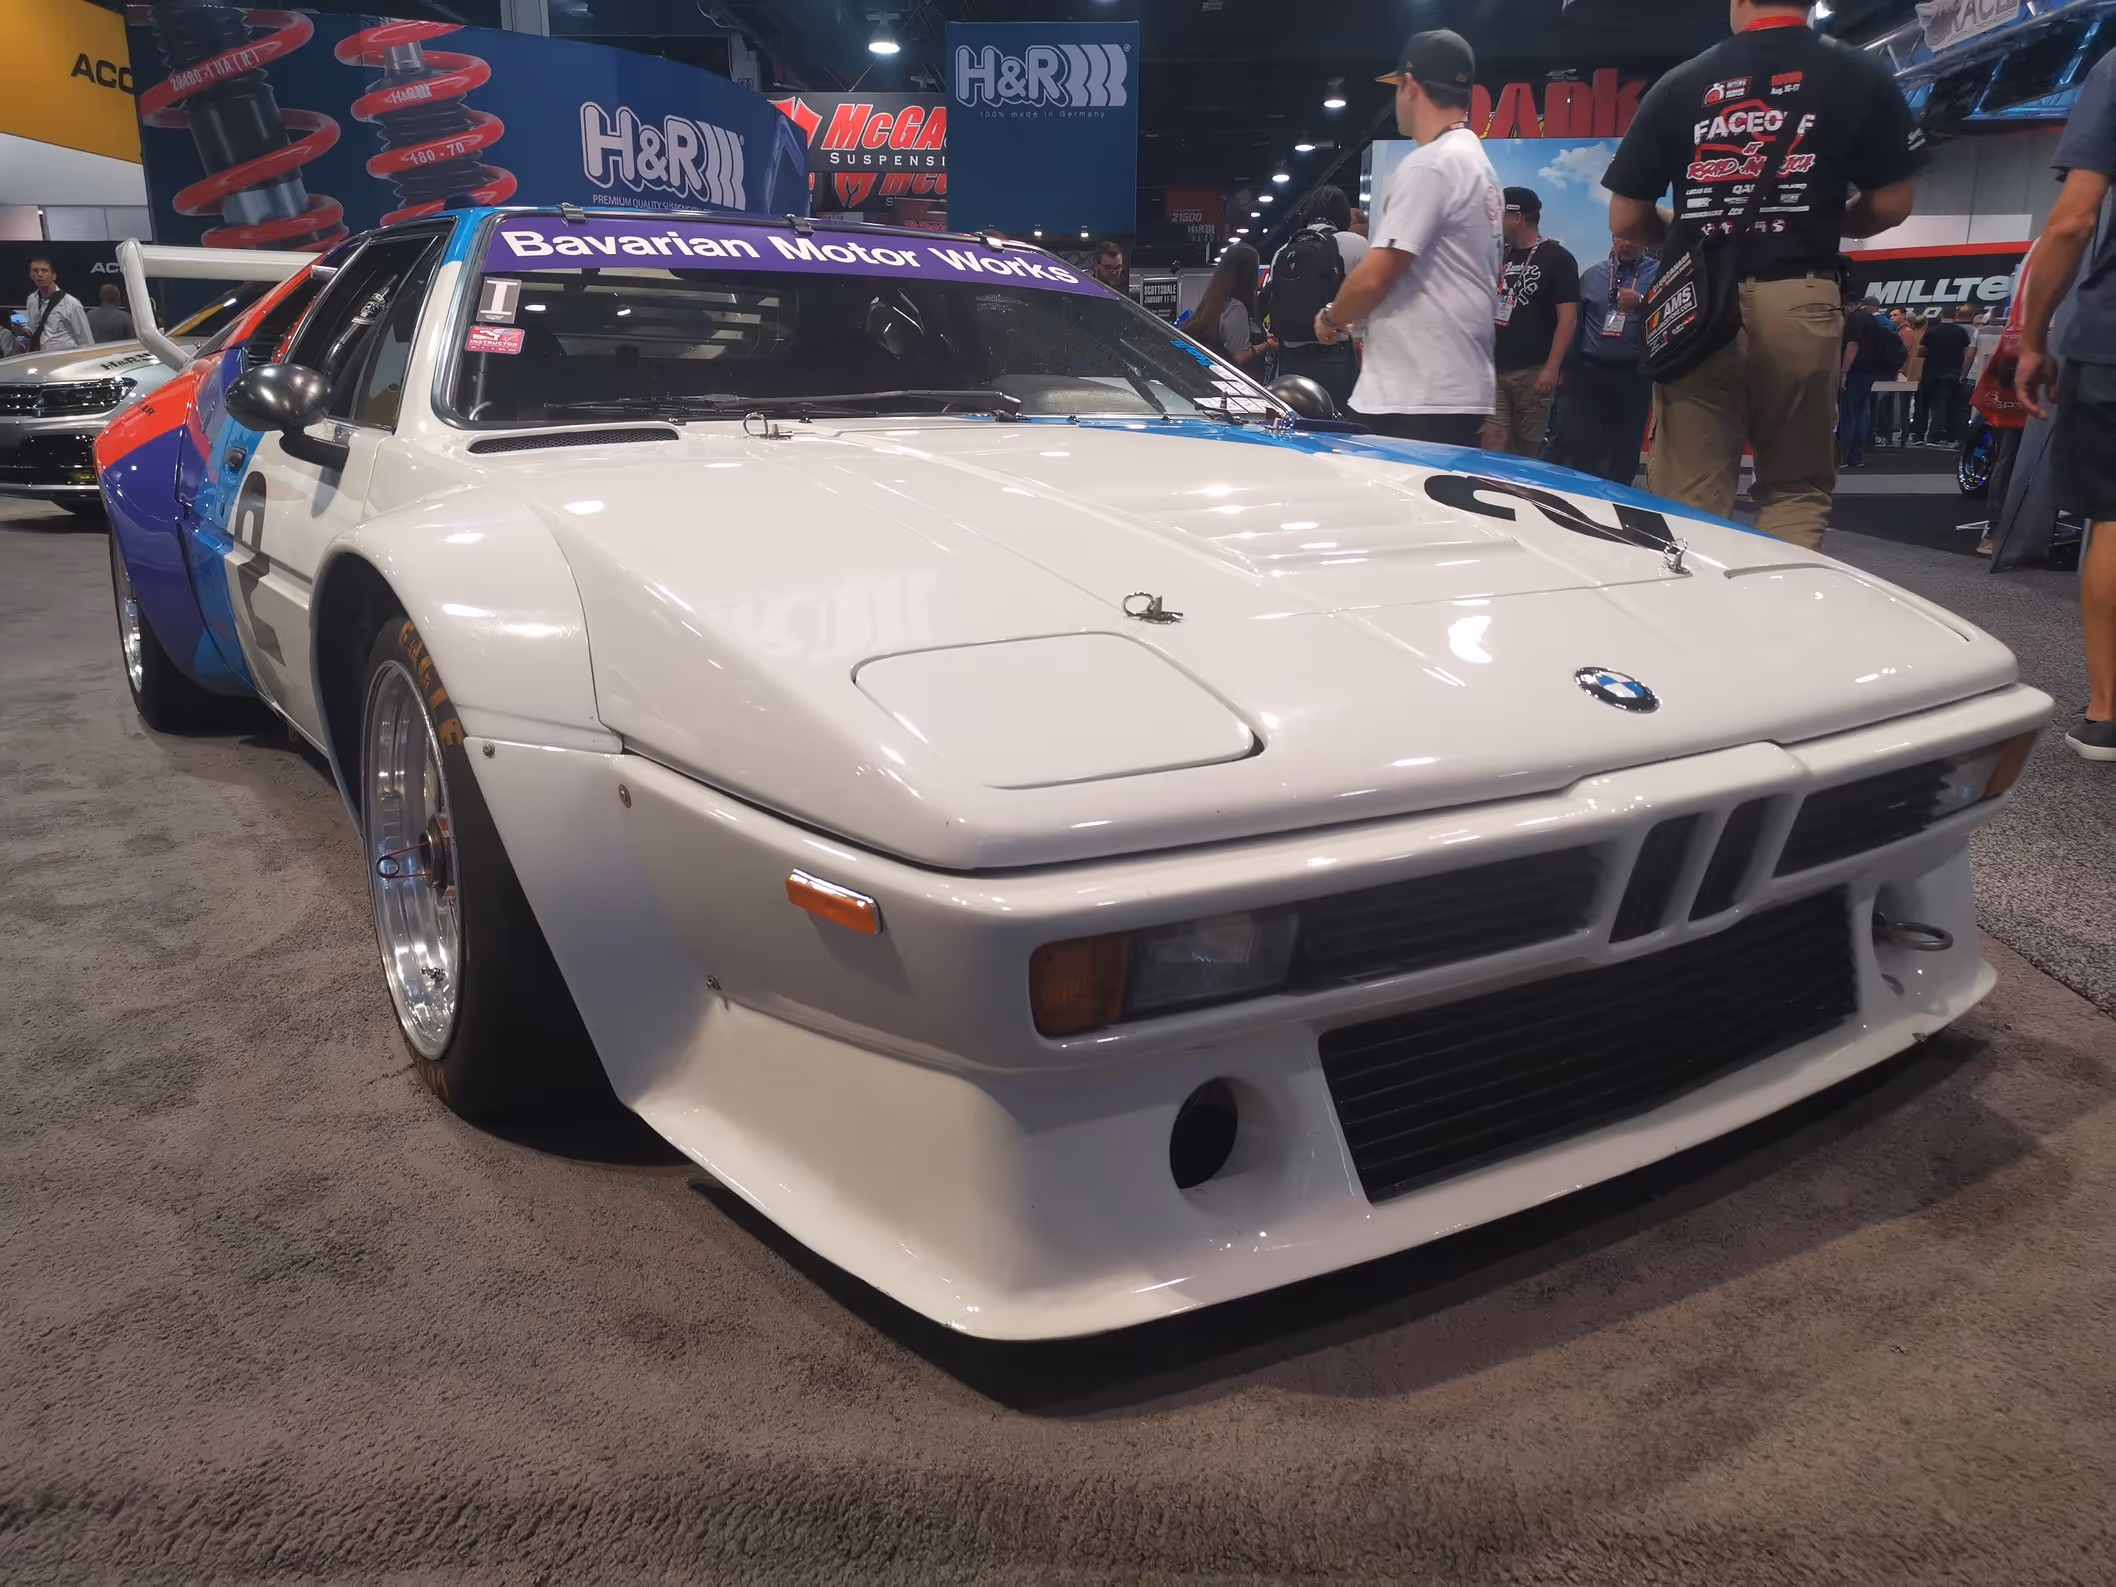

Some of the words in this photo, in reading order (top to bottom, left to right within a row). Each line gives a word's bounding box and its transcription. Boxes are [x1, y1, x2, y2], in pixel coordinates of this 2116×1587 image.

[956, 45, 1069, 107] H&R
[820, 104, 947, 151] McGA
[1059, 111, 1105, 119] Germany
[1694, 110, 1816, 146] FACEOF
[410, 149, 436, 165] 180
[447, 141, 465, 156] 70
[580, 101, 710, 202] H&R
[593, 194, 631, 207] PREMIUM
[633, 199, 662, 210] QUALITY
[1172, 212, 1203, 222] 21500
[500, 230, 760, 258] Bavarian
[767, 235, 922, 268] Motor
[927, 247, 1079, 284] Works
[1143, 284, 1177, 296] SCOTTSDALE
[1663, 287, 1692, 319] AMS
[470, 339, 518, 347] INSTRUCTOR
